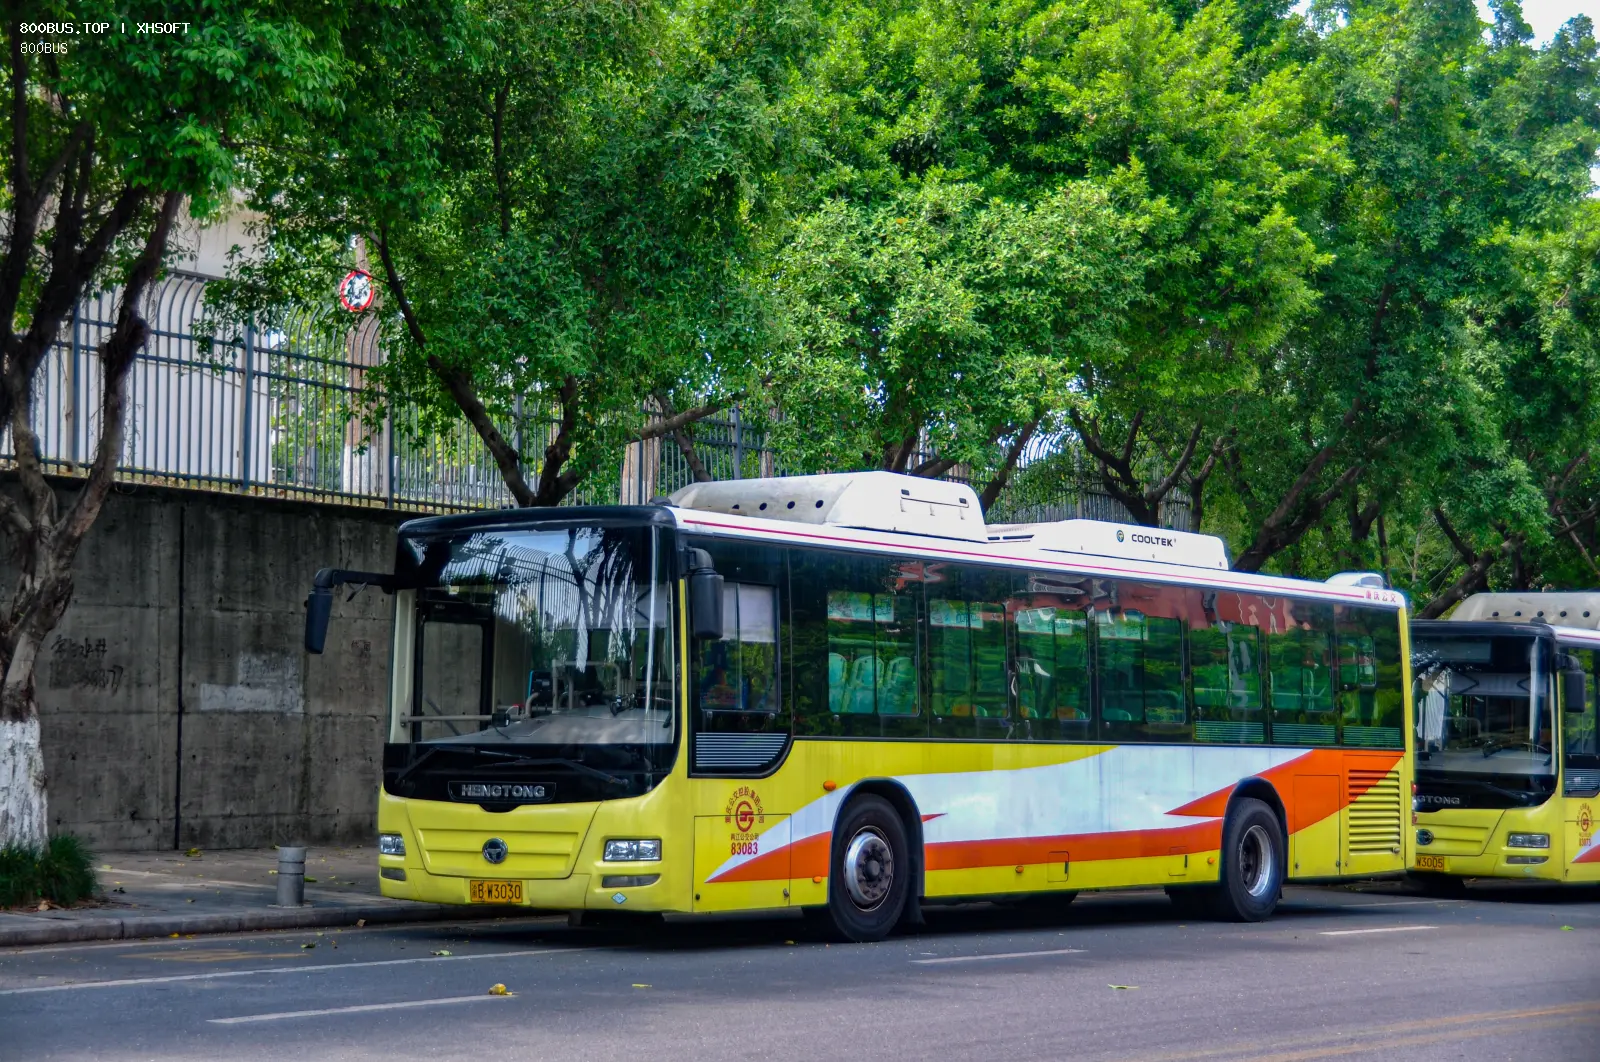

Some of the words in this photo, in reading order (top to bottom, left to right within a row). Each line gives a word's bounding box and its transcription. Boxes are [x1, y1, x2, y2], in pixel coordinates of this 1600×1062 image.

[1131, 534, 1173, 547] COOLTEK
[461, 784, 545, 798] HENGTONG
[730, 842, 758, 856] 83083
